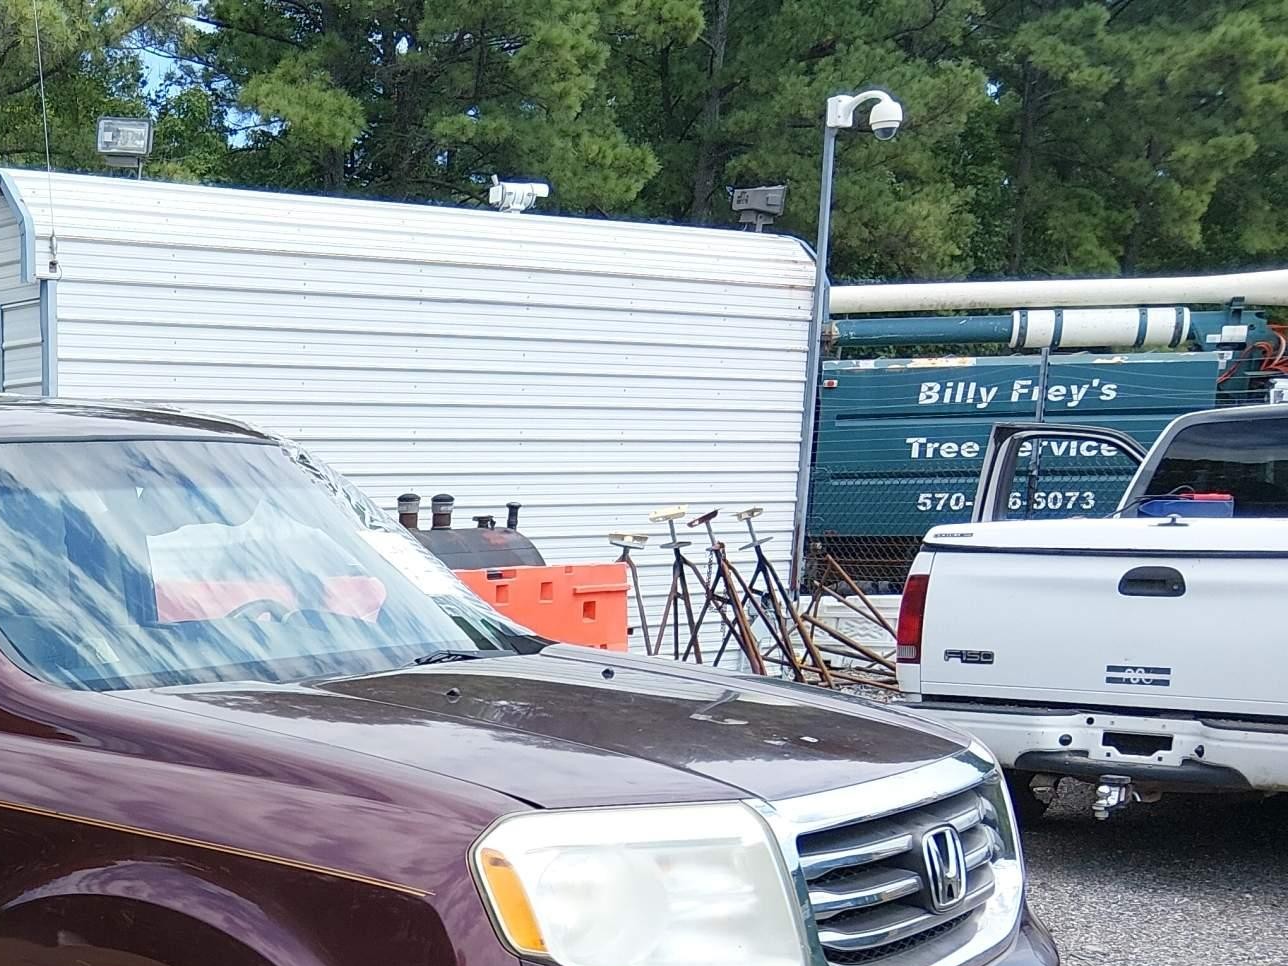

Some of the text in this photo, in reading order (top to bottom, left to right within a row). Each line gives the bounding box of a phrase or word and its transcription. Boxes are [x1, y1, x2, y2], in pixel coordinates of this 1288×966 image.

[918, 381, 998, 408] Billy
[905, 437, 1119, 459] Tree ervice
